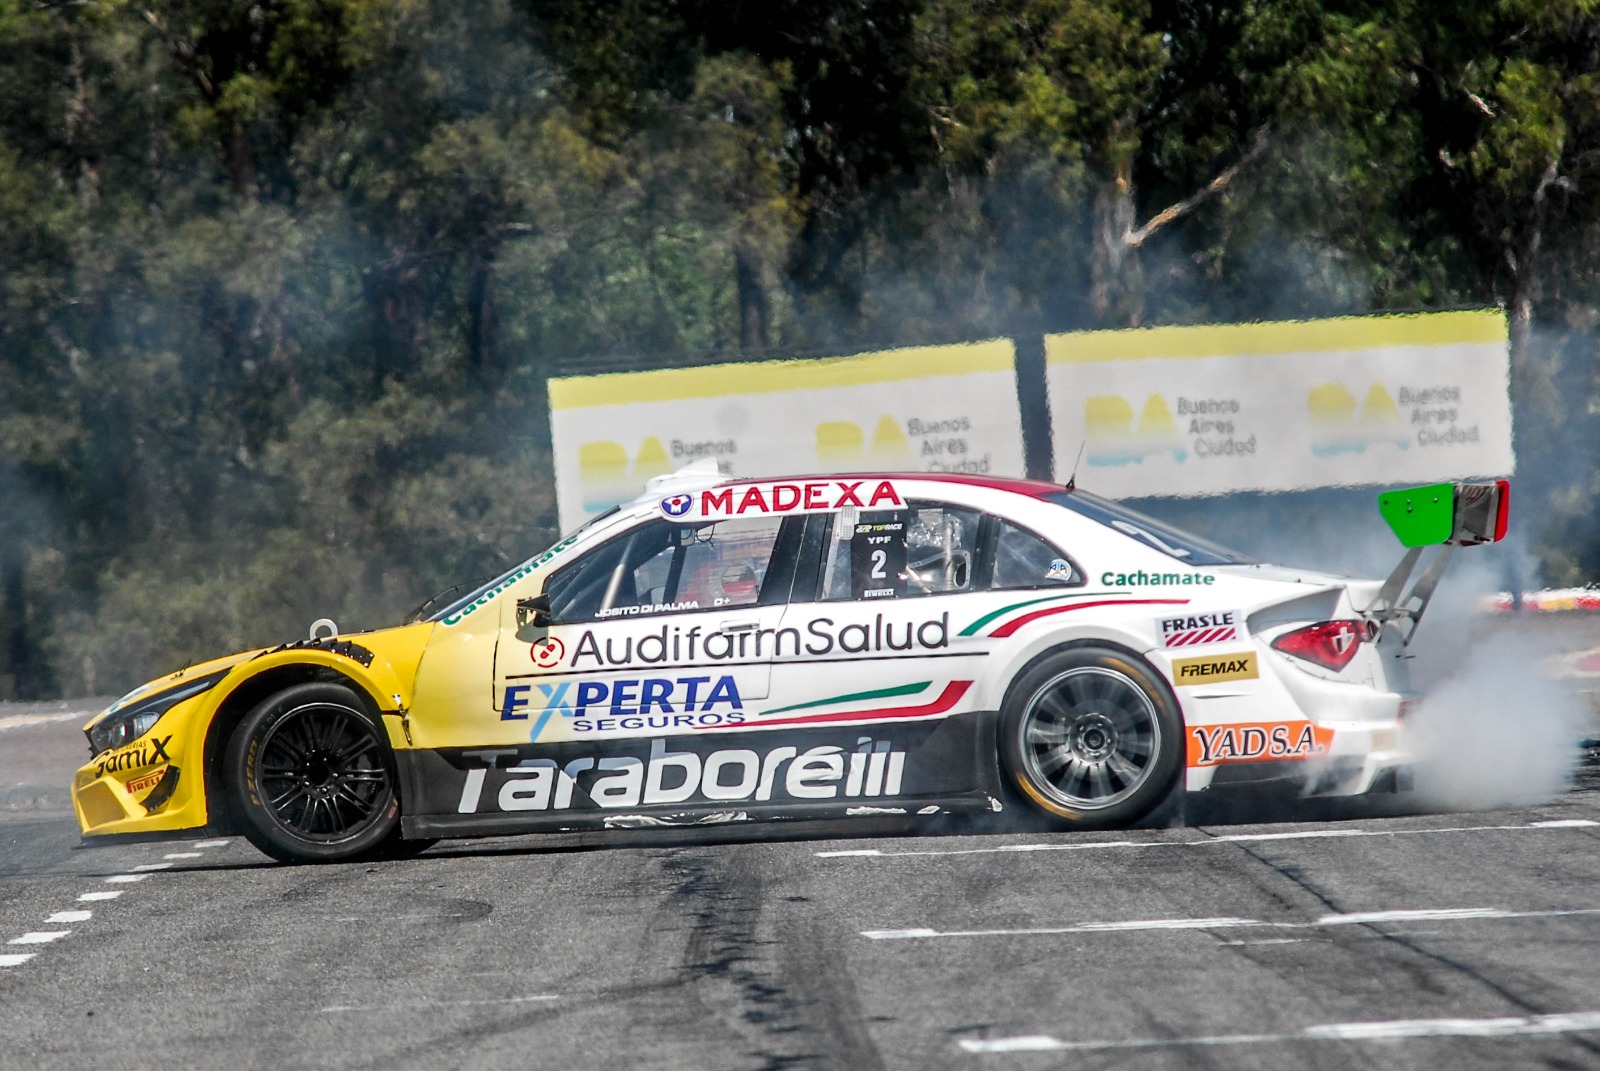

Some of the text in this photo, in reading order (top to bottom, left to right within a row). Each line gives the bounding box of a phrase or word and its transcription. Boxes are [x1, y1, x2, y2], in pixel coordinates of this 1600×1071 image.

[1398, 384, 1463, 405] Buenos
[1177, 396, 1241, 417] Buenos
[1410, 406, 1458, 425] Aires
[906, 416, 971, 437] Buenos
[1188, 419, 1236, 436] Aires
[1416, 425, 1481, 446] Ciudad
[671, 439, 738, 456] Buenos
[921, 437, 969, 457] Aires
[1194, 435, 1257, 457] Ciudad
[701, 480, 902, 516] MADEXA
[867, 536, 892, 545] YPF
[871, 549, 887, 579] 2
[1100, 568, 1216, 588] Cachamate
[594, 605, 640, 618] JOSITO
[640, 604, 653, 614] DI
[652, 600, 699, 613] PALMA
[571, 611, 949, 667] AudifarmSalud
[1180, 658, 1249, 678] FREMAX
[500, 674, 744, 743] EXPERTA
[572, 711, 746, 731] SEGUROS
[1194, 724, 1323, 763] YAD S.A.
